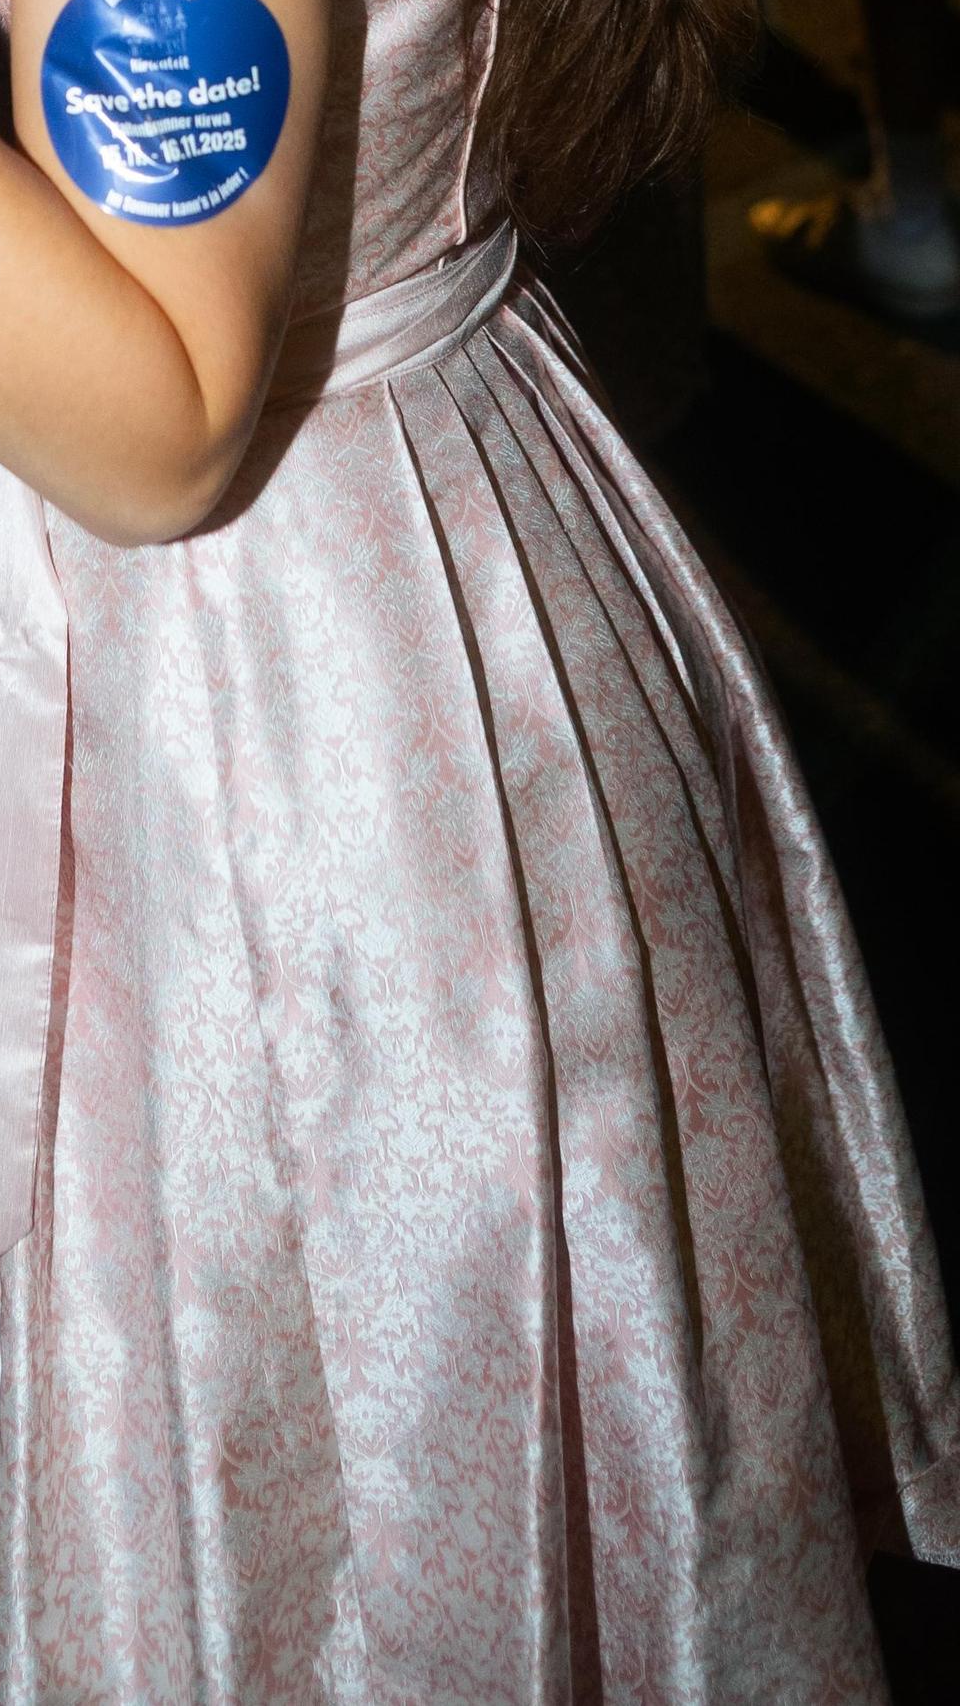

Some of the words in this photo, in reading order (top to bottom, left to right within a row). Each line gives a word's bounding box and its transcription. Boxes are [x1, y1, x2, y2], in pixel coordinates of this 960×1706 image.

[65, 87, 130, 115] Save
[133, 82, 183, 110] the
[188, 66, 261, 106] date!
[194, 111, 232, 130] Kirwa
[159, 128, 247, 163] 16.11.2025
